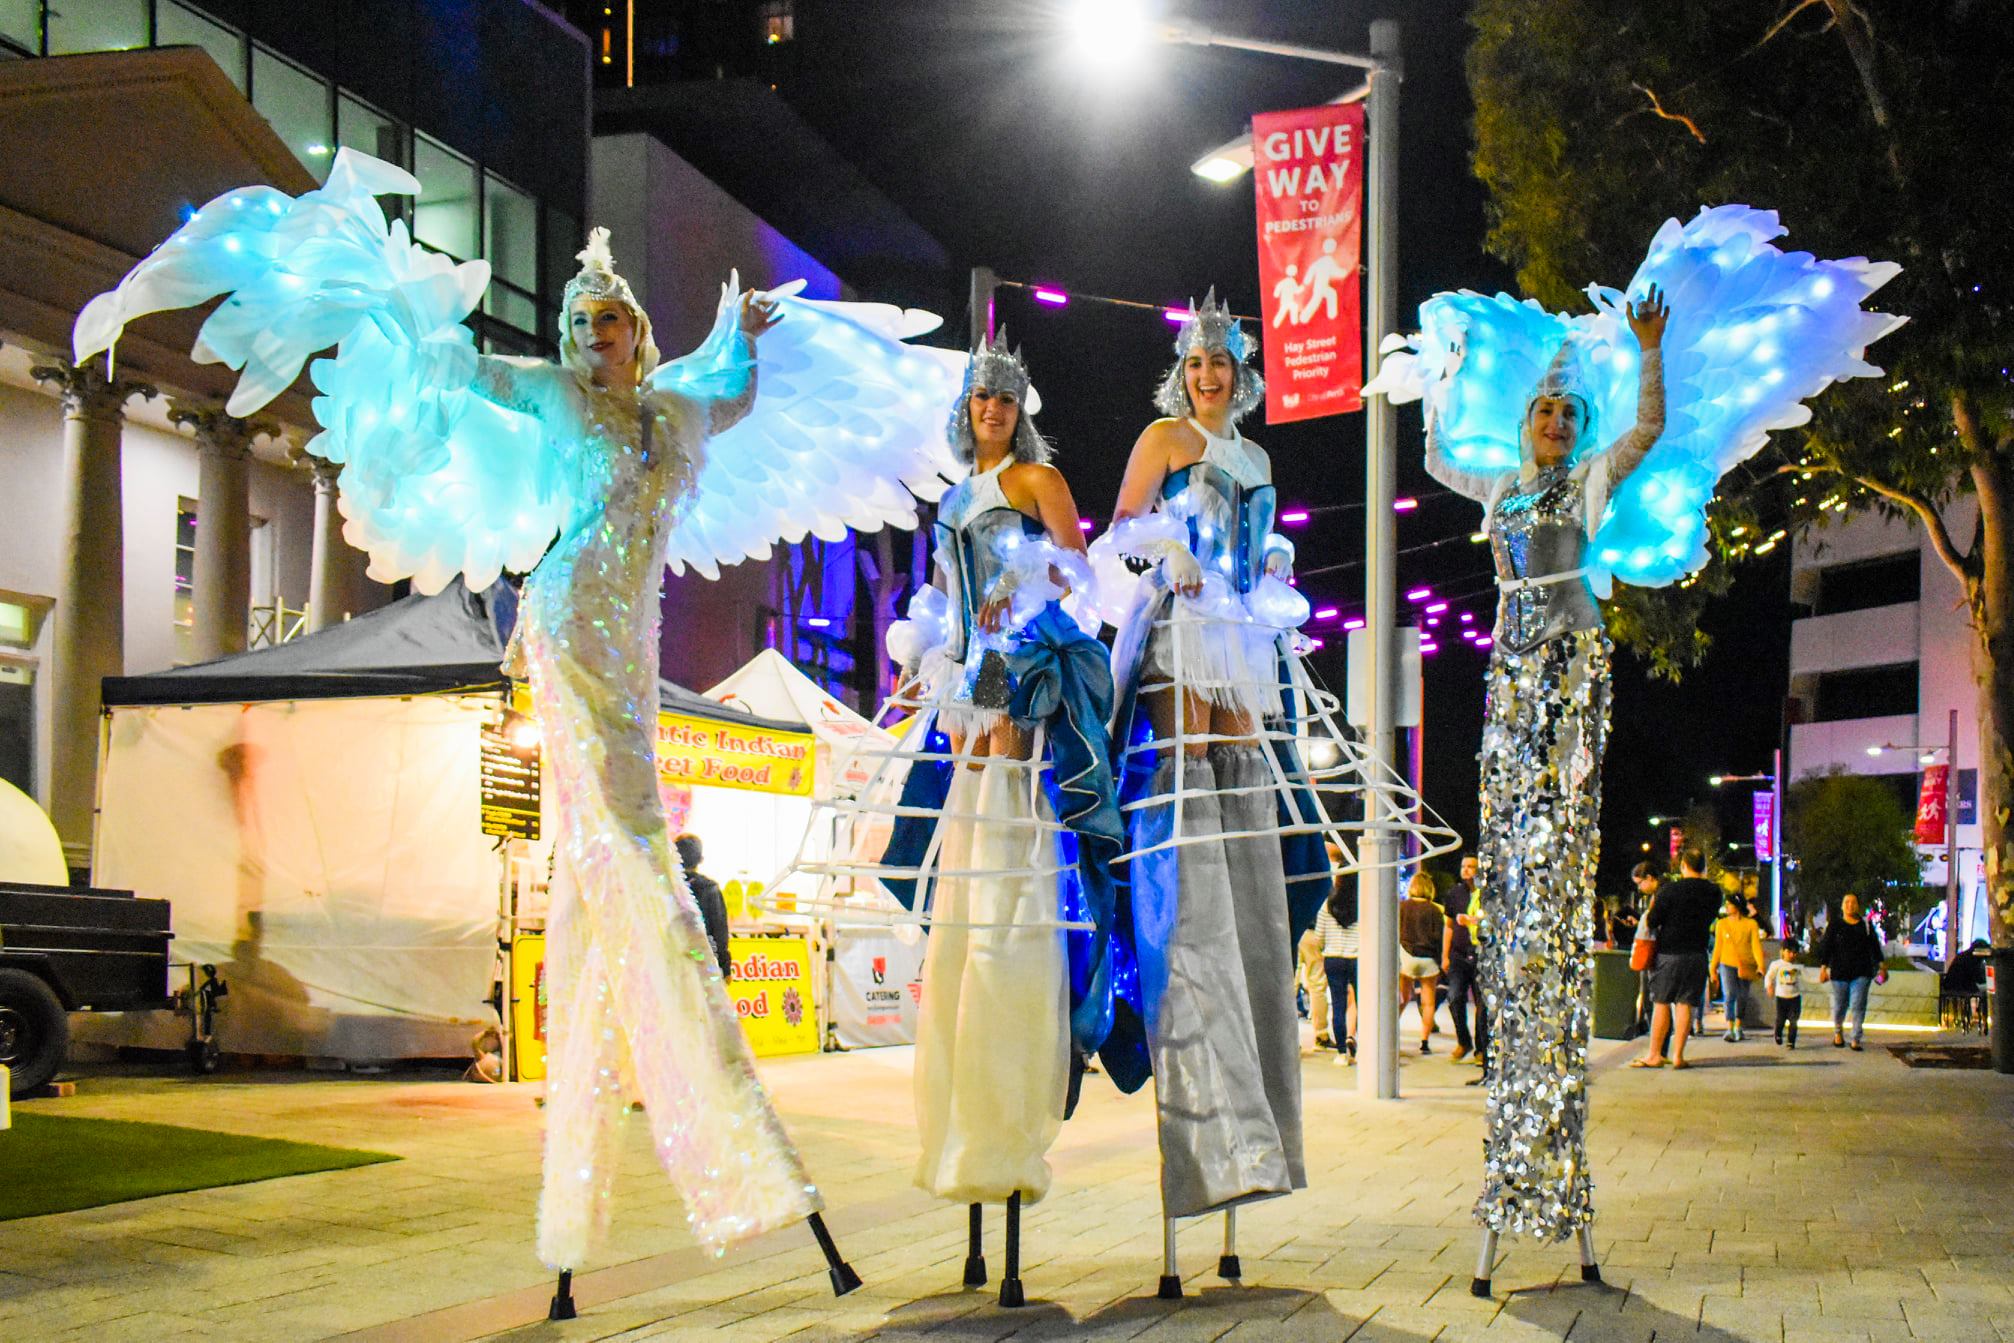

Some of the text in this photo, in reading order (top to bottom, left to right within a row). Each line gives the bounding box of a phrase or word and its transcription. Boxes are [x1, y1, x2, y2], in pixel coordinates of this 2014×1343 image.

[1264, 124, 1352, 161] GIVE
[1267, 160, 1351, 199] WAY
[1300, 200, 1320, 212] TO
[1284, 336, 1336, 355] Hay Street
[1285, 352, 1337, 367] Pedestrian
[1292, 366, 1329, 381] Priority
[717, 730, 807, 760] Indian
[704, 757, 772, 785] Food
[730, 955, 800, 979] ndian
[735, 991, 769, 1016] od
[866, 990, 900, 1002] CATERING
